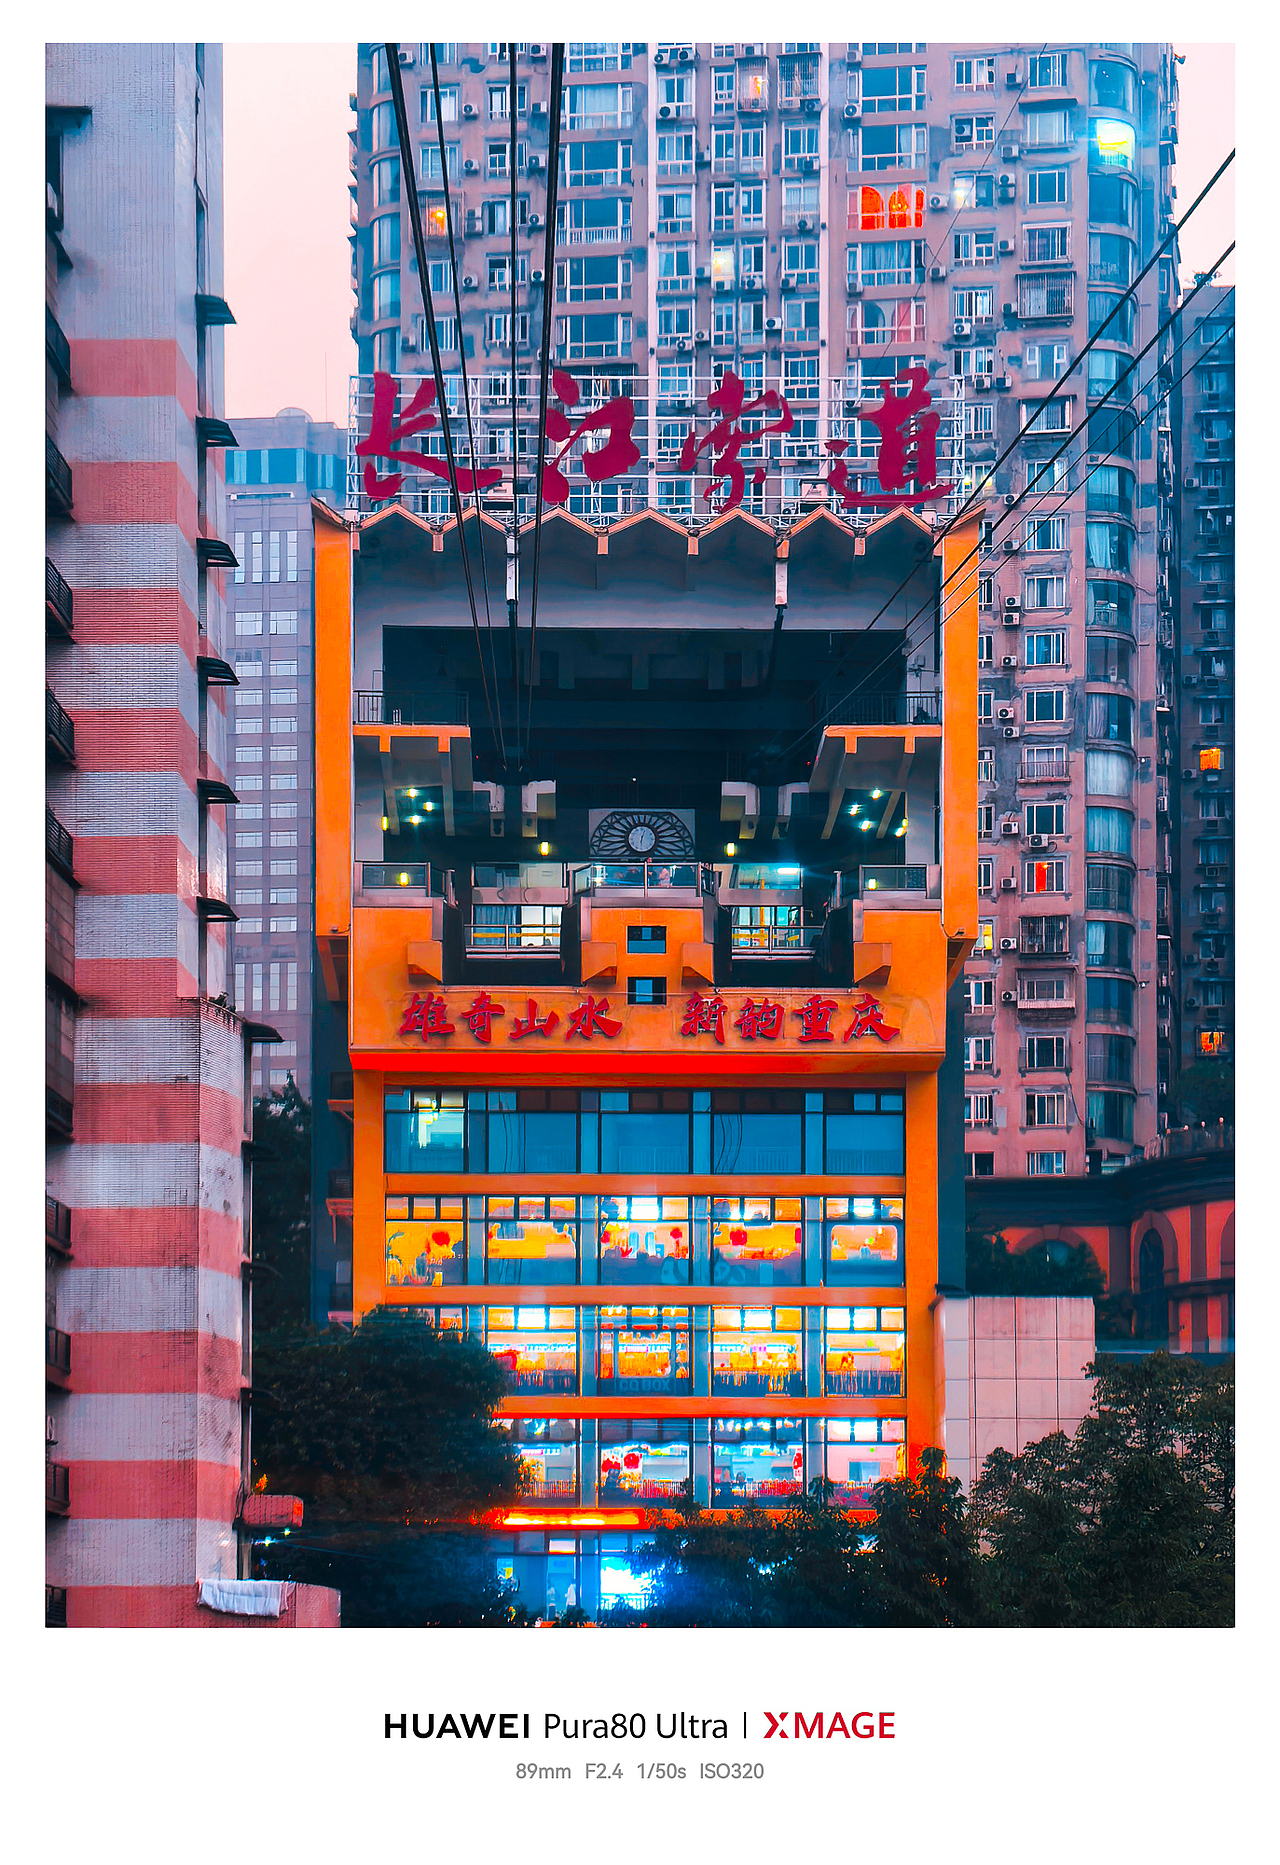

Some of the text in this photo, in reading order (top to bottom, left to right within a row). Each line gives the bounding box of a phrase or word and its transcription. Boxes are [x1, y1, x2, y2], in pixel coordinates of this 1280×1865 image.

[355, 367, 955, 514] 长江索道
[398, 989, 901, 1045] 雄奇山水 新韵重庆
